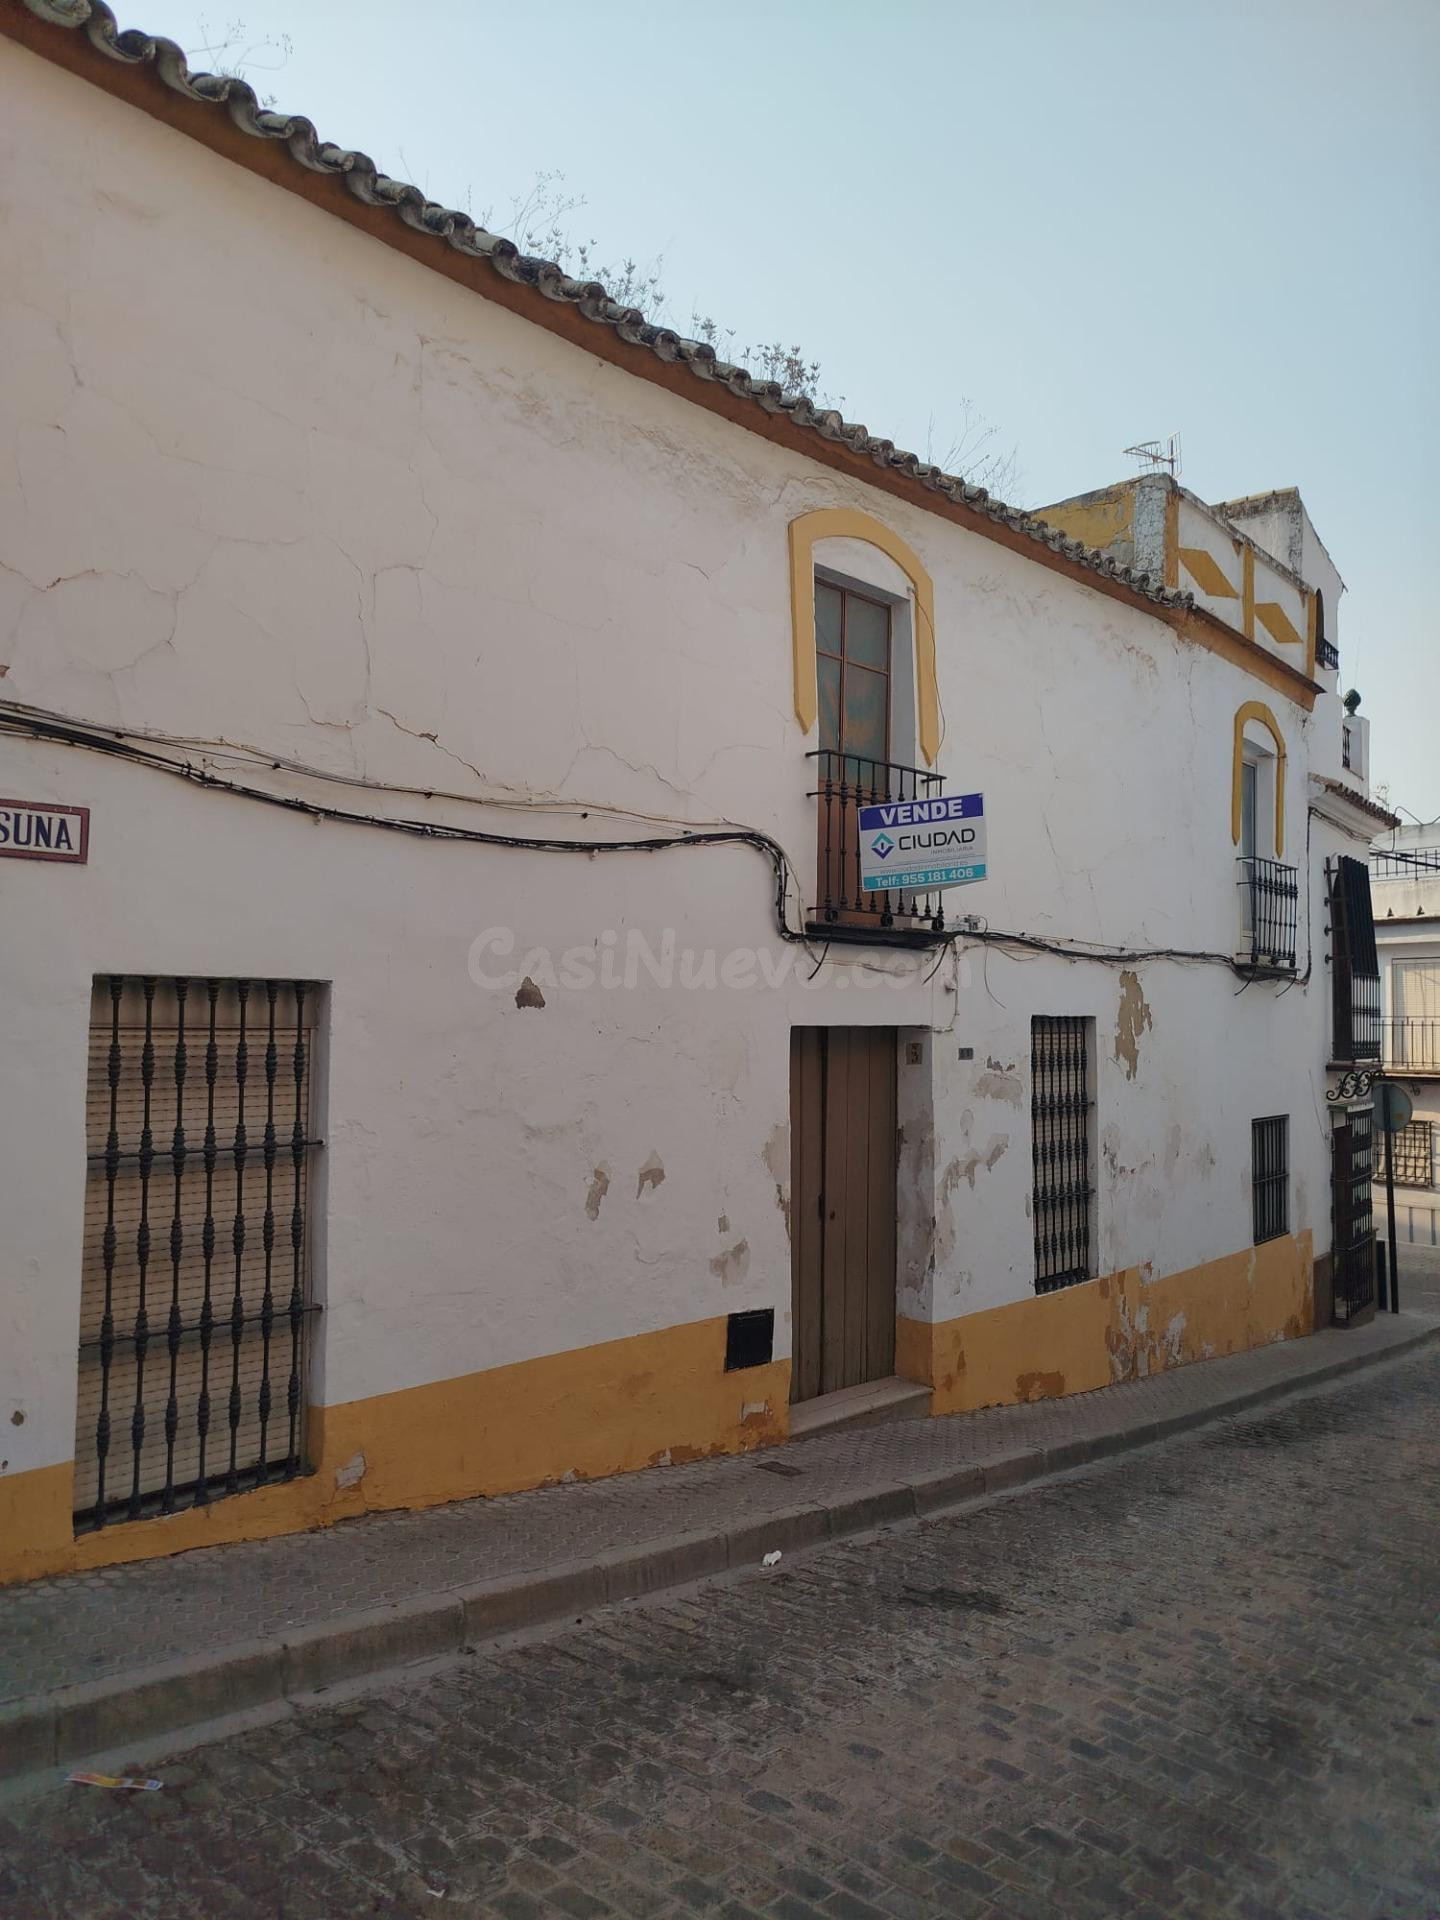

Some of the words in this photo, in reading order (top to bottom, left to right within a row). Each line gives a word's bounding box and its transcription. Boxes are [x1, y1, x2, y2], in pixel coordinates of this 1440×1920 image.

[880, 799, 963, 825] VENDE
[898, 828, 975, 851] CIUDAD
[875, 877, 899, 887] Telf:
[902, 873, 925, 884] 955
[928, 871, 945, 881] 181
[949, 868, 973, 879] 406
